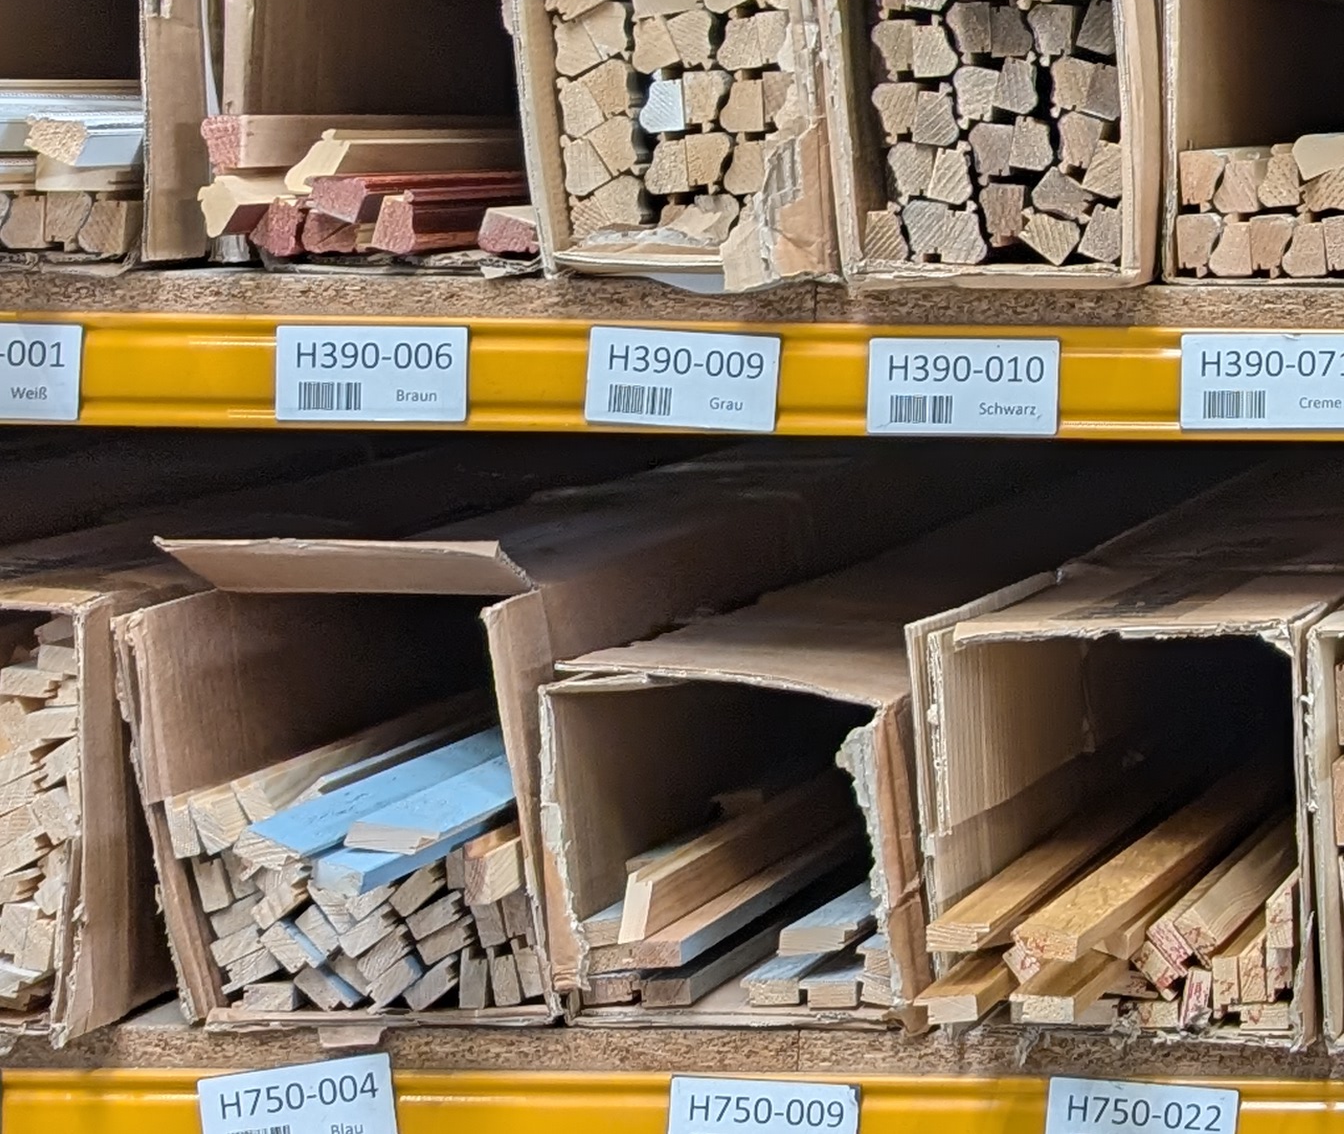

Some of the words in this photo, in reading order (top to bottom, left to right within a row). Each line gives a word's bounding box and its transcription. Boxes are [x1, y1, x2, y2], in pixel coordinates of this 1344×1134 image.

[296, 341, 453, 370] H390-006
[608, 343, 764, 380] H390-009
[888, 354, 1045, 384] H390-010
[10, 386, 48, 401] Weiß
[396, 388, 438, 403] Braun
[709, 396, 744, 412] Grau
[1298, 396, 1343, 409] Creme
[978, 401, 1037, 416] Schwarz
[219, 1071, 379, 1120] H750-004
[689, 1094, 844, 1128] H750-009
[1067, 1094, 1221, 1132] H750-022
